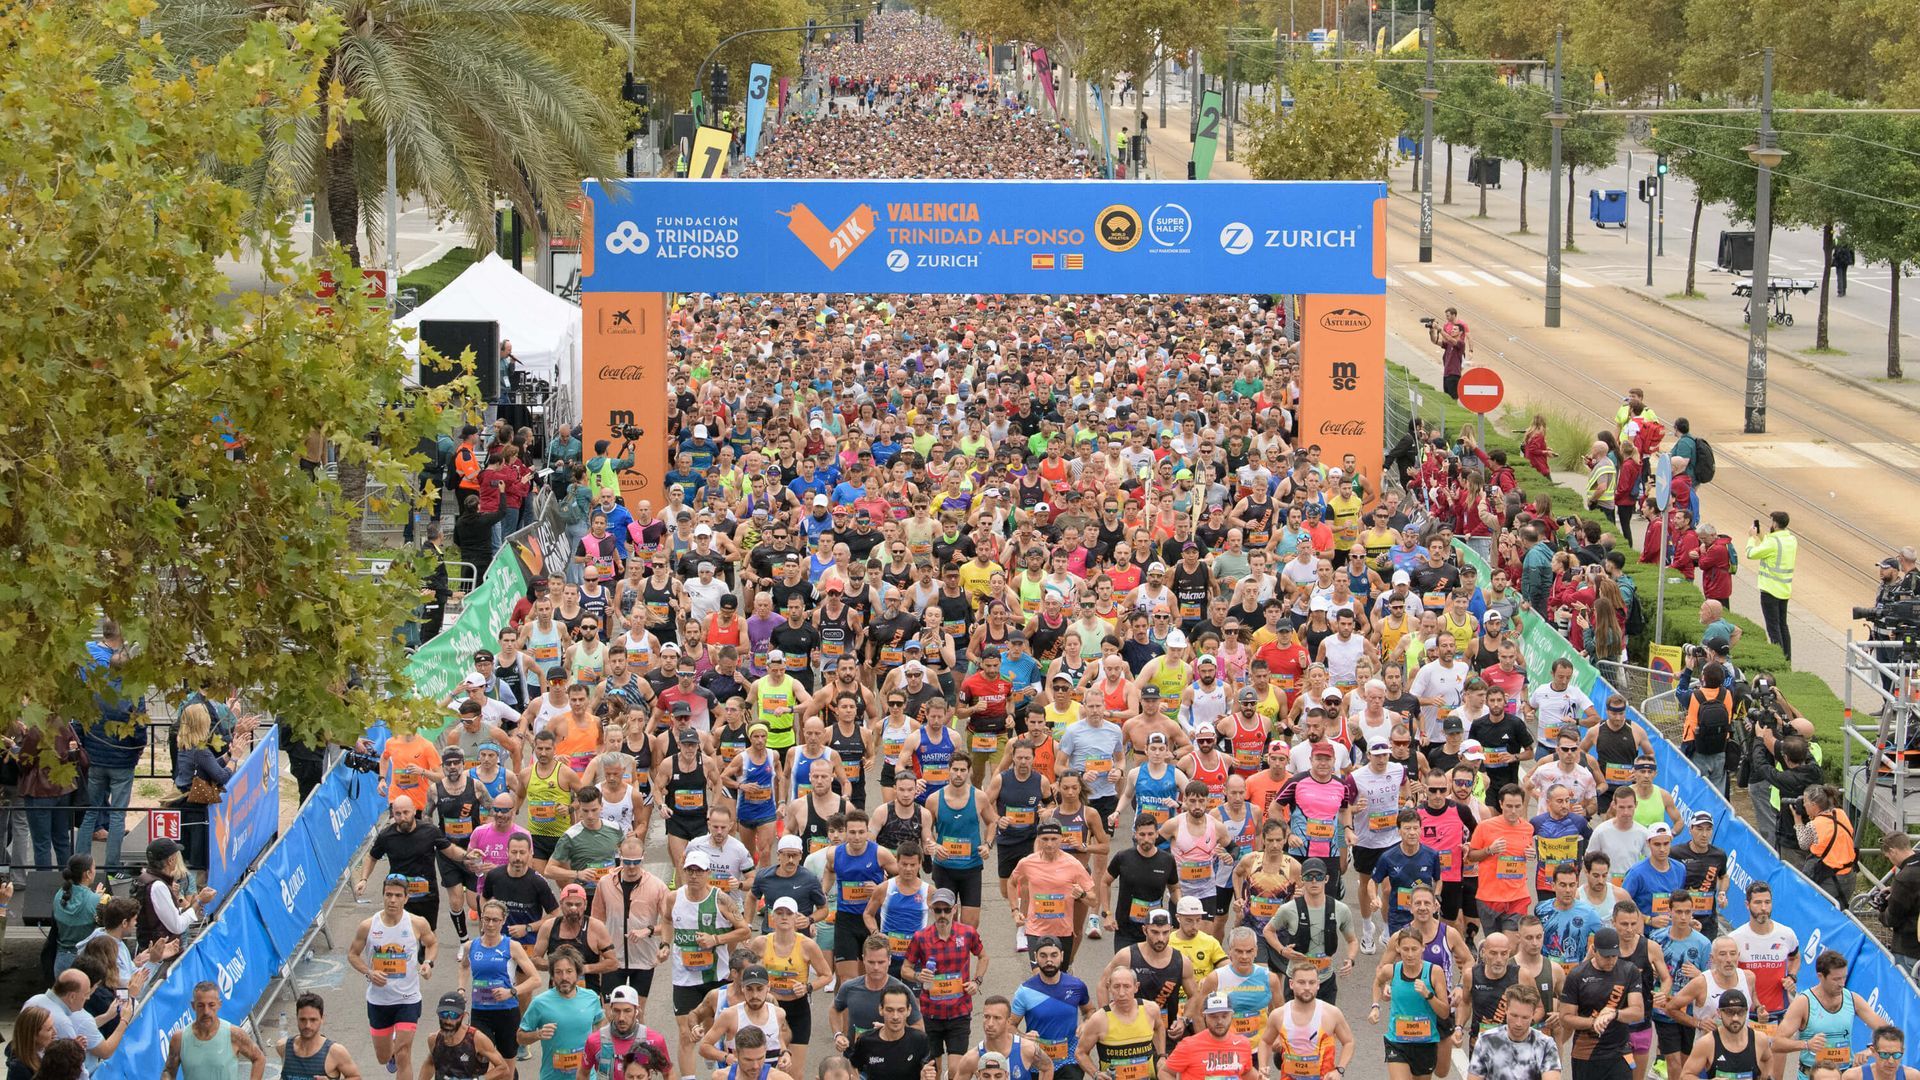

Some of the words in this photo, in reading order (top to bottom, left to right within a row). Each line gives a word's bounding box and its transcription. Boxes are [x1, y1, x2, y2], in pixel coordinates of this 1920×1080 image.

[750, 75, 767, 100] 3
[1199, 106, 1220, 140] 2
[702, 146, 722, 179] 1
[656, 215, 738, 226] FUNDACIÓN
[887, 203, 979, 222] VALENCIA
[656, 229, 738, 244] TRINIDAD
[828, 216, 867, 260] 21K
[888, 228, 982, 245] TRINIDAD
[987, 229, 1085, 245] ALFONSO
[1264, 229, 1357, 247] ZURICH
[656, 244, 738, 259] ALFONSO
[917, 254, 979, 268] ZURICH
[1324, 316, 1368, 326] ASTURIANA
[598, 364, 644, 381] Coca-Cola
[1319, 419, 1366, 436] Coca-Cola
[619, 479, 645, 487] RIANA
[1699, 866, 1718, 892] ENCIA
